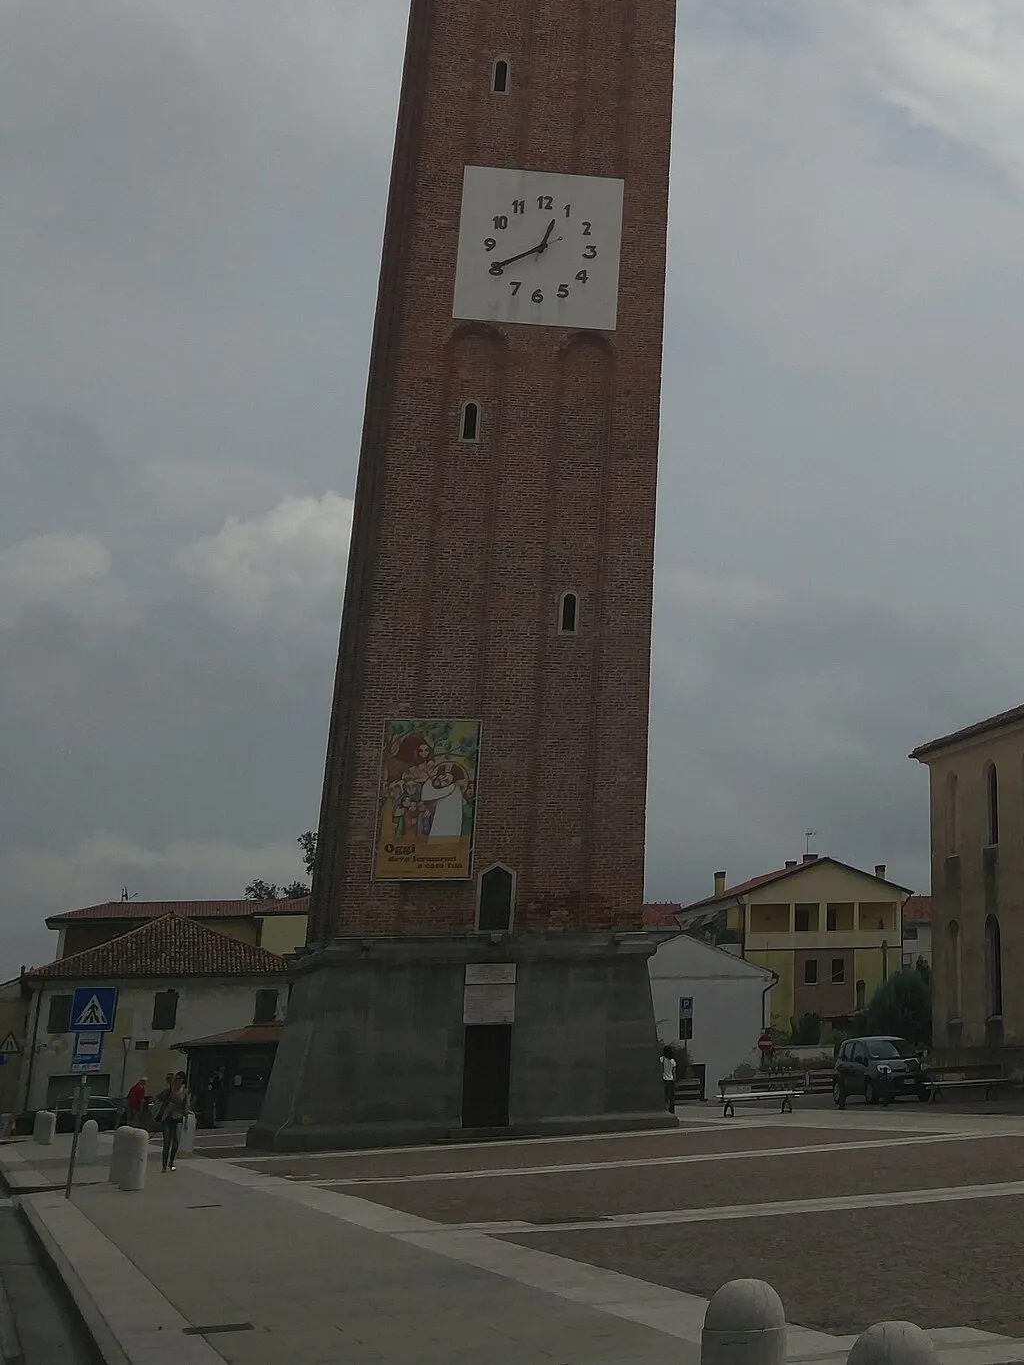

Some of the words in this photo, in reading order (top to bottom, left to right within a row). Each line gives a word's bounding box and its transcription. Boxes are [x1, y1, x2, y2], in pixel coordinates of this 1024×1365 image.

[511, 199, 525, 214] 11
[537, 195, 553, 210] 12
[563, 204, 571, 218] 1
[492, 215, 508, 230] 10
[581, 221, 592, 236] 2
[484, 237, 497, 252] 9
[582, 245, 597, 259] 3
[488, 261, 504, 276] 8
[575, 269, 589, 283] 4
[509, 281, 522, 296] 7
[531, 288, 544, 303] 6
[556, 284, 569, 298] 5
[384, 843, 416, 855] Oggi
